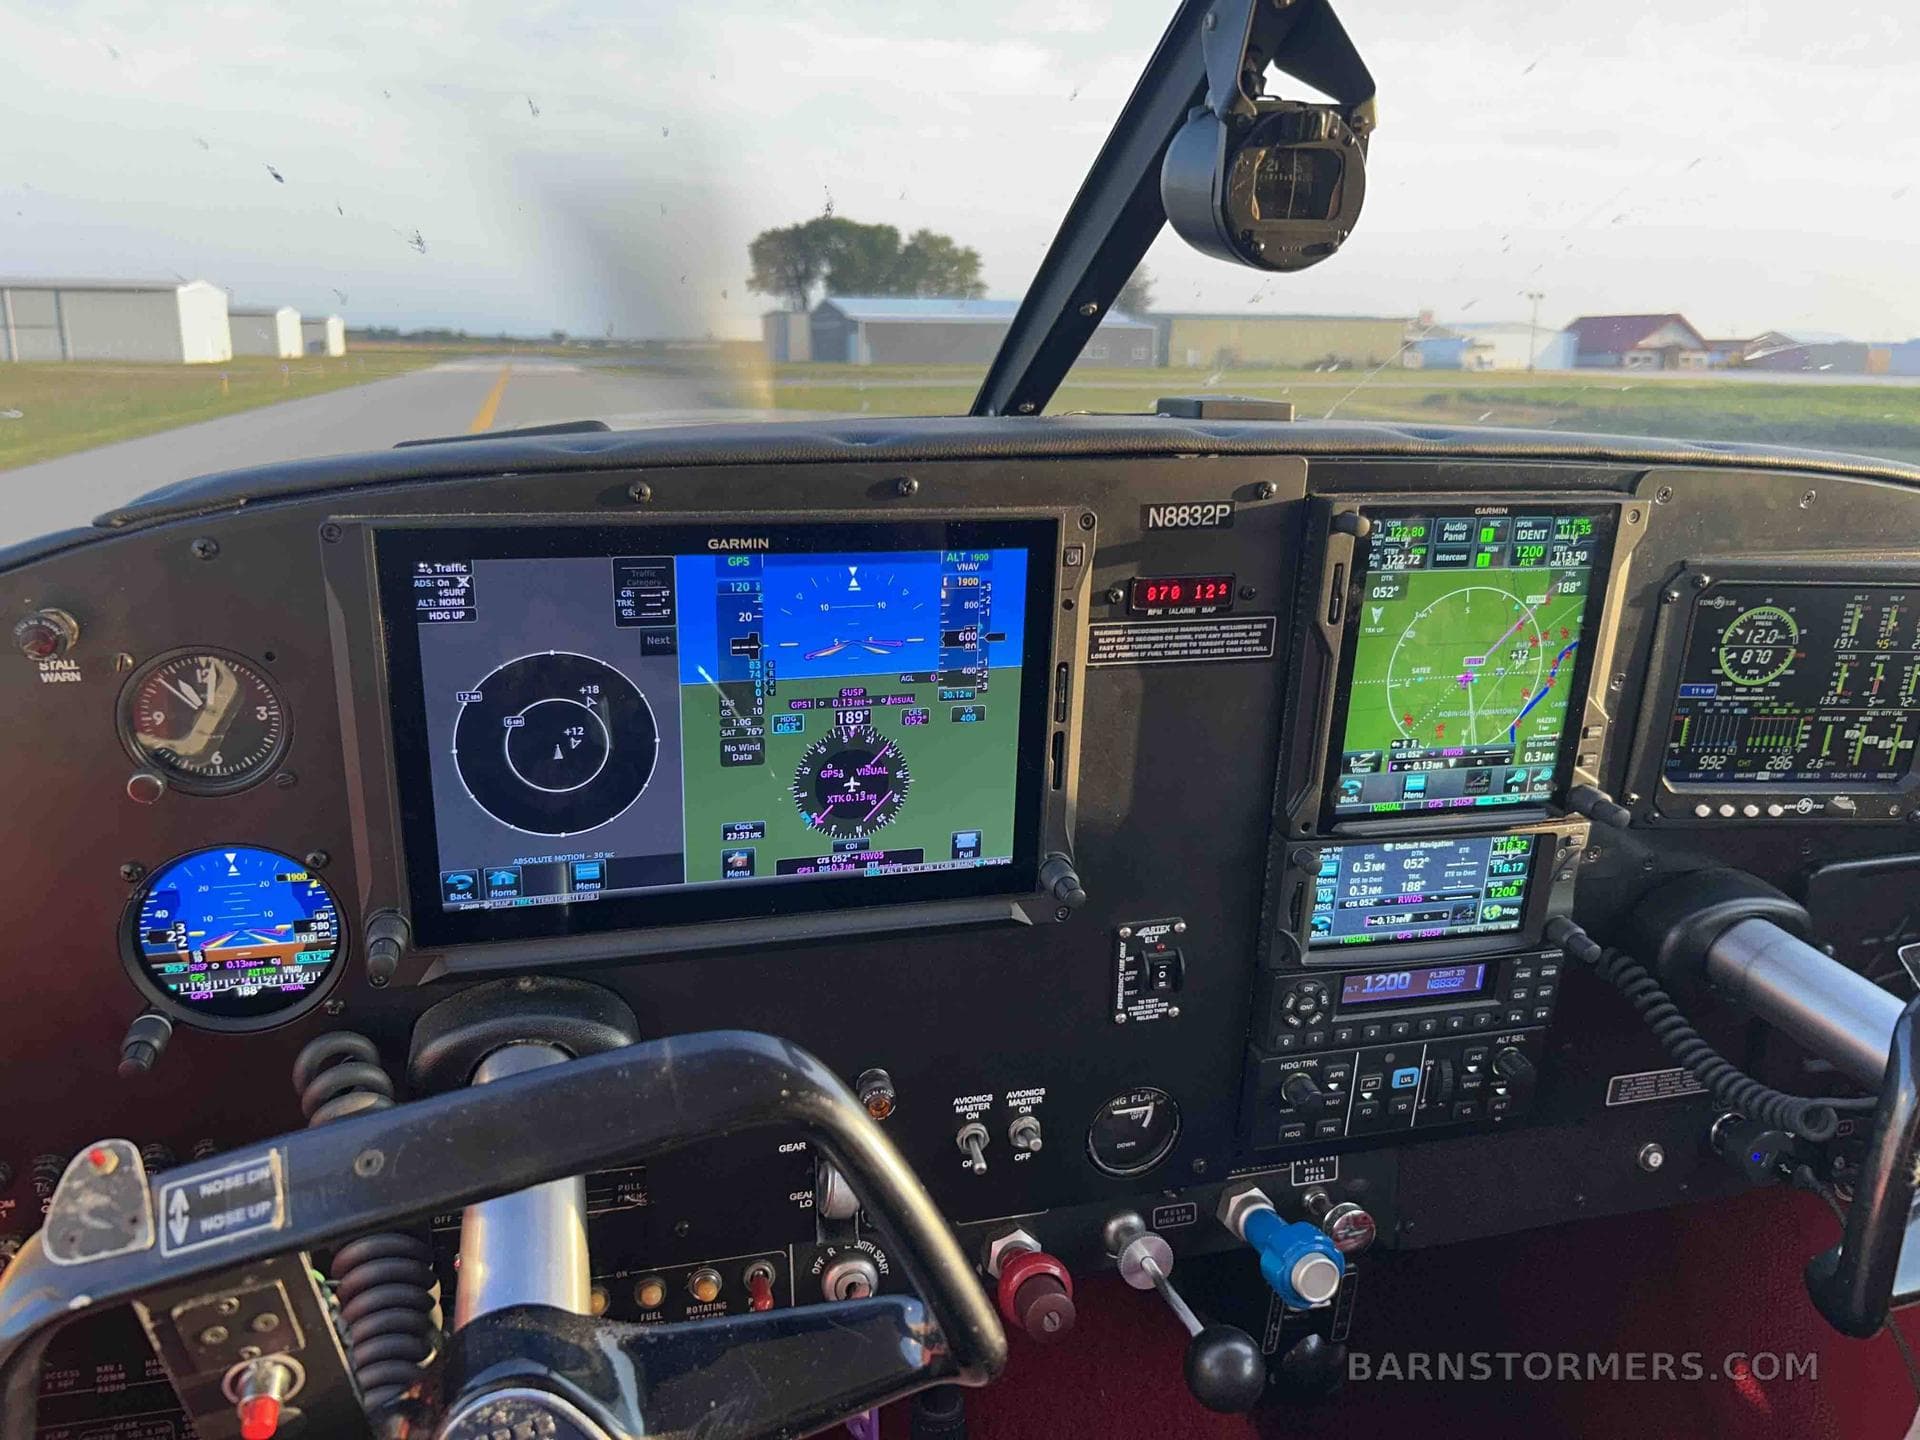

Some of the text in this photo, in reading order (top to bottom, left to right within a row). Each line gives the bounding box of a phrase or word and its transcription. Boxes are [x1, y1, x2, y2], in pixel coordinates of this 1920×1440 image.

[1475, 507, 1508, 515] GARMIN
[1148, 504, 1231, 529] N8832P
[1444, 523, 1468, 531] Audio
[1390, 527, 1425, 538] 122.80
[1443, 532, 1466, 541] Panel
[1516, 529, 1547, 540] IDENT
[708, 538, 769, 550] GARMIN
[1436, 553, 1467, 561] Intercom
[1516, 546, 1543, 558] 1200
[1555, 551, 1588, 562] 113.50
[727, 557, 750, 567] GPS
[946, 553, 989, 562] ALT 1900
[1386, 555, 1420, 565] 122.72
[1520, 559, 1535, 567] ALT
[434, 563, 467, 574] Traffic
[414, 579, 449, 588] ADS: On
[957, 577, 979, 586] 1900
[730, 582, 750, 592] 120
[1372, 586, 1399, 598] 052°
[1147, 585, 1182, 601] 870
[418, 598, 465, 607] ALT: NORM
[617, 599, 635, 607] TRK:
[429, 611, 465, 621] HDG UP
[739, 612, 752, 622] 20
[646, 634, 671, 646] Next
[958, 631, 977, 641] 600
[1745, 629, 1779, 644] 12.0
[1741, 649, 1773, 664] 870
[39, 659, 79, 670] STALL
[40, 671, 81, 683] WARN
[579, 685, 600, 695] +18
[841, 688, 864, 697] SUSP
[790, 701, 812, 709] GPS1
[153, 711, 165, 726] 9
[256, 706, 268, 721] 3
[837, 710, 869, 724] 189°
[960, 714, 976, 722] 400
[732, 718, 751, 726] 1.0G
[564, 726, 584, 736] +12
[724, 742, 760, 752] No Wind
[211, 751, 223, 765] 6
[732, 753, 753, 761] Data
[1699, 755, 1727, 770] 992
[1765, 755, 1794, 770] 286
[1806, 759, 1824, 769] 2.6
[856, 767, 888, 776] VISUAL
[1534, 783, 1547, 791] Out
[1403, 791, 1424, 799] Menu
[1372, 803, 1401, 812] VISUAL
[1428, 800, 1444, 808] GPS
[1453, 798, 1474, 807] SUSP
[726, 832, 750, 840] 23:53
[860, 851, 884, 860] RW05
[1352, 862, 1385, 873] 0.3 NM
[1403, 857, 1430, 869] 052°
[1493, 863, 1524, 873] 118.17
[727, 870, 750, 878] Menu
[576, 882, 600, 890] Menu
[1316, 877, 1336, 885] Menu
[1400, 880, 1426, 892] 188°
[491, 889, 517, 898] Home
[1349, 885, 1368, 896] 0.3
[1490, 887, 1518, 898] 1200
[450, 892, 473, 901] Back
[1345, 900, 1358, 908] crs
[1397, 895, 1423, 904] RW05
[1315, 903, 1332, 911] MSG
[1136, 925, 1170, 936] ARTEX
[1397, 930, 1413, 939] GPS
[1422, 928, 1441, 938] SUSP
[1344, 935, 1371, 943] VISUAL
[1430, 970, 1455, 979] FLIGHT
[1362, 972, 1411, 993] 1200
[1426, 977, 1465, 990] N8832P
[281, 984, 305, 992] VISUAL
[190, 991, 214, 1000] GPS1
[1496, 1034, 1525, 1044] ALT SEL
[1280, 1059, 1318, 1070] HDG/TRK
[1006, 1087, 1046, 1099] AVIONICS
[953, 1094, 993, 1105] AVIONICS
[1008, 1096, 1043, 1107] MASTER
[955, 1102, 990, 1113] MASTER
[1018, 1105, 1031, 1114] ON
[966, 1111, 979, 1120] ON
[1284, 1130, 1300, 1138] HDG
[1322, 1126, 1336, 1134] TRK
[778, 1141, 806, 1153] GEAR
[1116, 1141, 1136, 1149] DOWN
[1014, 1152, 1031, 1161] OFF
[200, 1165, 271, 1198] NOSE DN
[1304, 1174, 1325, 1182] OPEN
[617, 1183, 641, 1191] PULL
[200, 1200, 272, 1233] NOSE UP
[434, 1216, 451, 1224] OFF
[812, 1256, 825, 1274] OFF
[827, 1248, 836, 1256] R
[874, 1250, 889, 1275] START
[686, 1302, 727, 1314] ROTATING
[640, 1312, 662, 1322] FUEL
